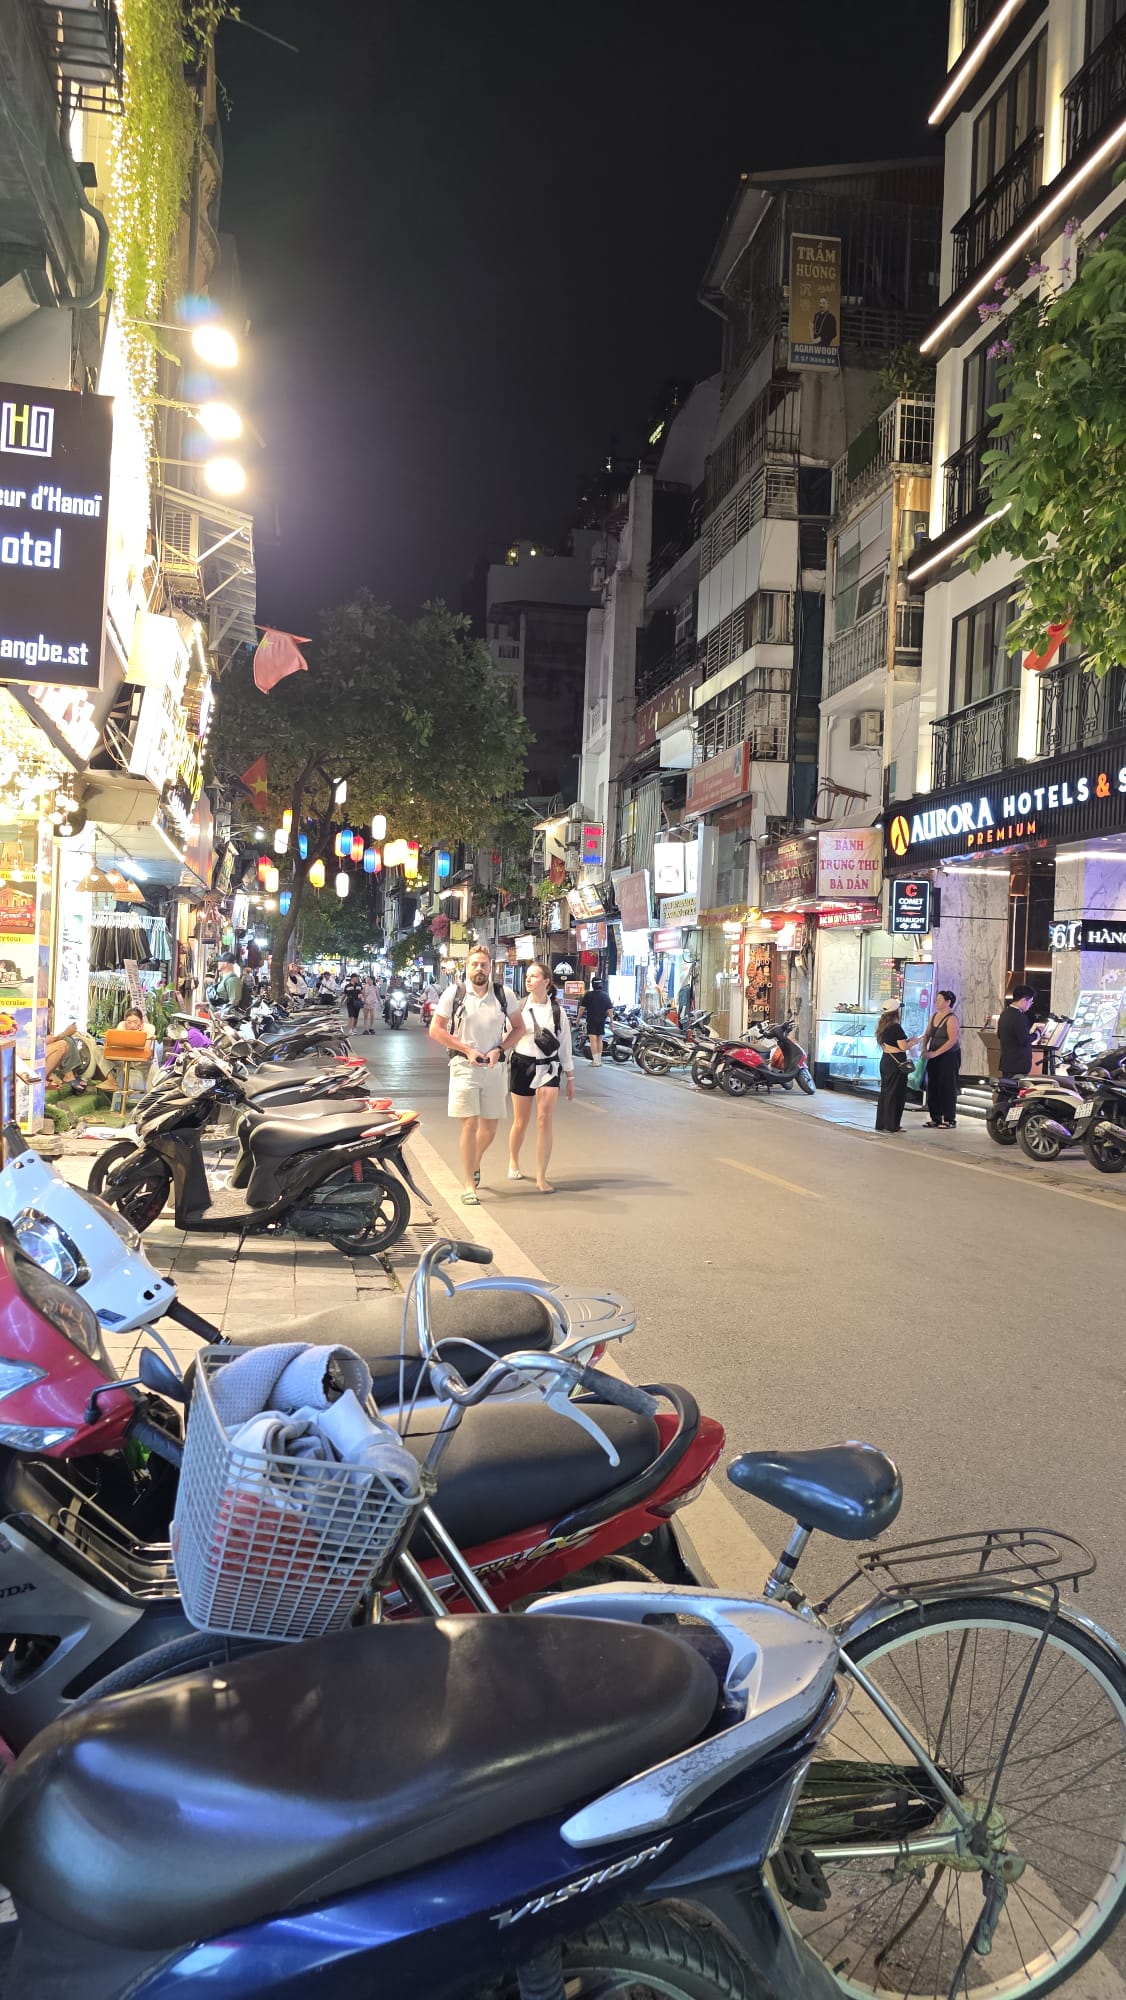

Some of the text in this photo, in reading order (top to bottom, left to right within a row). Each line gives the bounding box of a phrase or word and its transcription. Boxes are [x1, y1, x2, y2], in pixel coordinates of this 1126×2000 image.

[794, 343, 837, 356] AGARWOOD
[910, 797, 994, 844] AURORA
[1003, 777, 1089, 818] HOTELS
[1096, 773, 1110, 798] &
[967, 820, 1036, 847] PREMIUM
[820, 859, 880, 871] TRUNG THU
[898, 897, 924, 905] COMET
[489, 1837, 674, 1930] VISION
